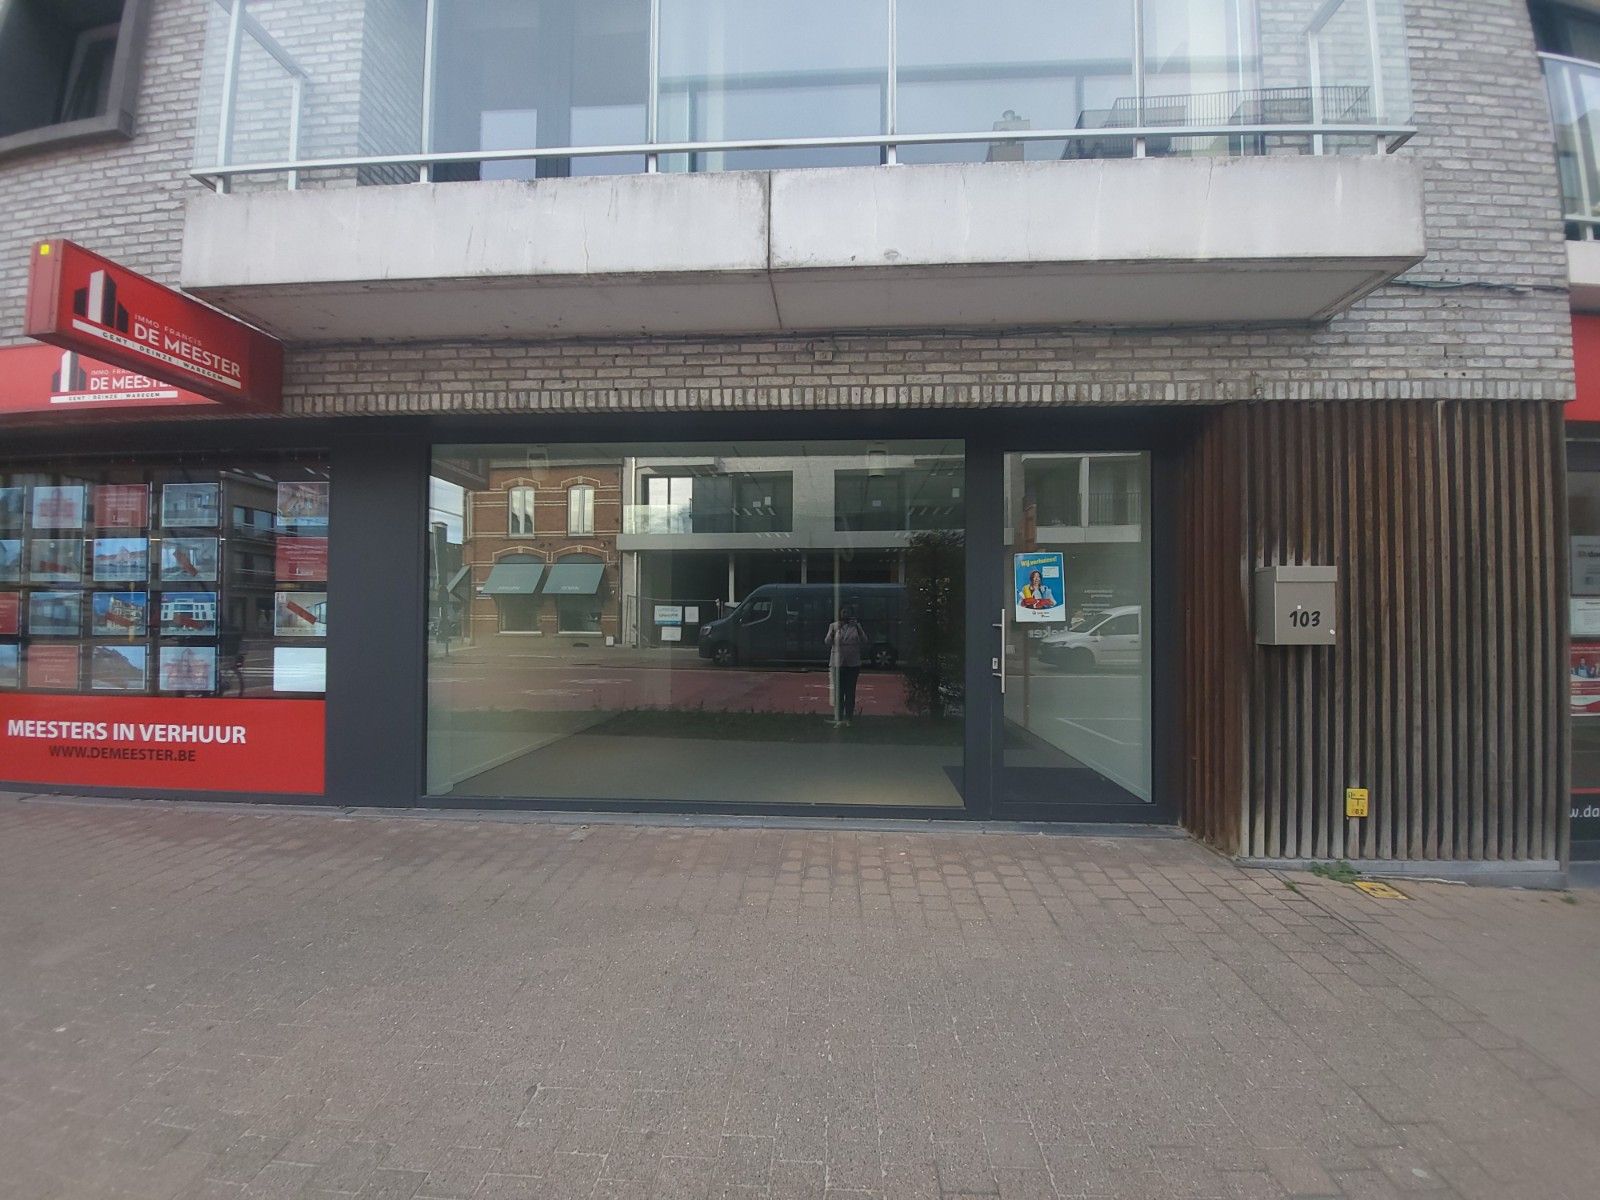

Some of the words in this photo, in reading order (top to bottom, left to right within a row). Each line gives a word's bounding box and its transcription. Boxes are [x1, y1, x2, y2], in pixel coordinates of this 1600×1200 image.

[134, 314, 160, 330] IMMO
[102, 331, 128, 346] GENT
[139, 344, 173, 362] DEINZE
[182, 360, 223, 381] WAREGEM
[134, 322, 160, 347] DE
[164, 334, 241, 377] MEESTER
[90, 377, 109, 391] DE
[1289, 610, 1321, 628] 103
[8, 719, 108, 741] MEESTERS
[113, 723, 135, 741] IN
[139, 724, 247, 744] VERHUUR
[49, 745, 196, 762] WWW.DEMEESTER.BE
